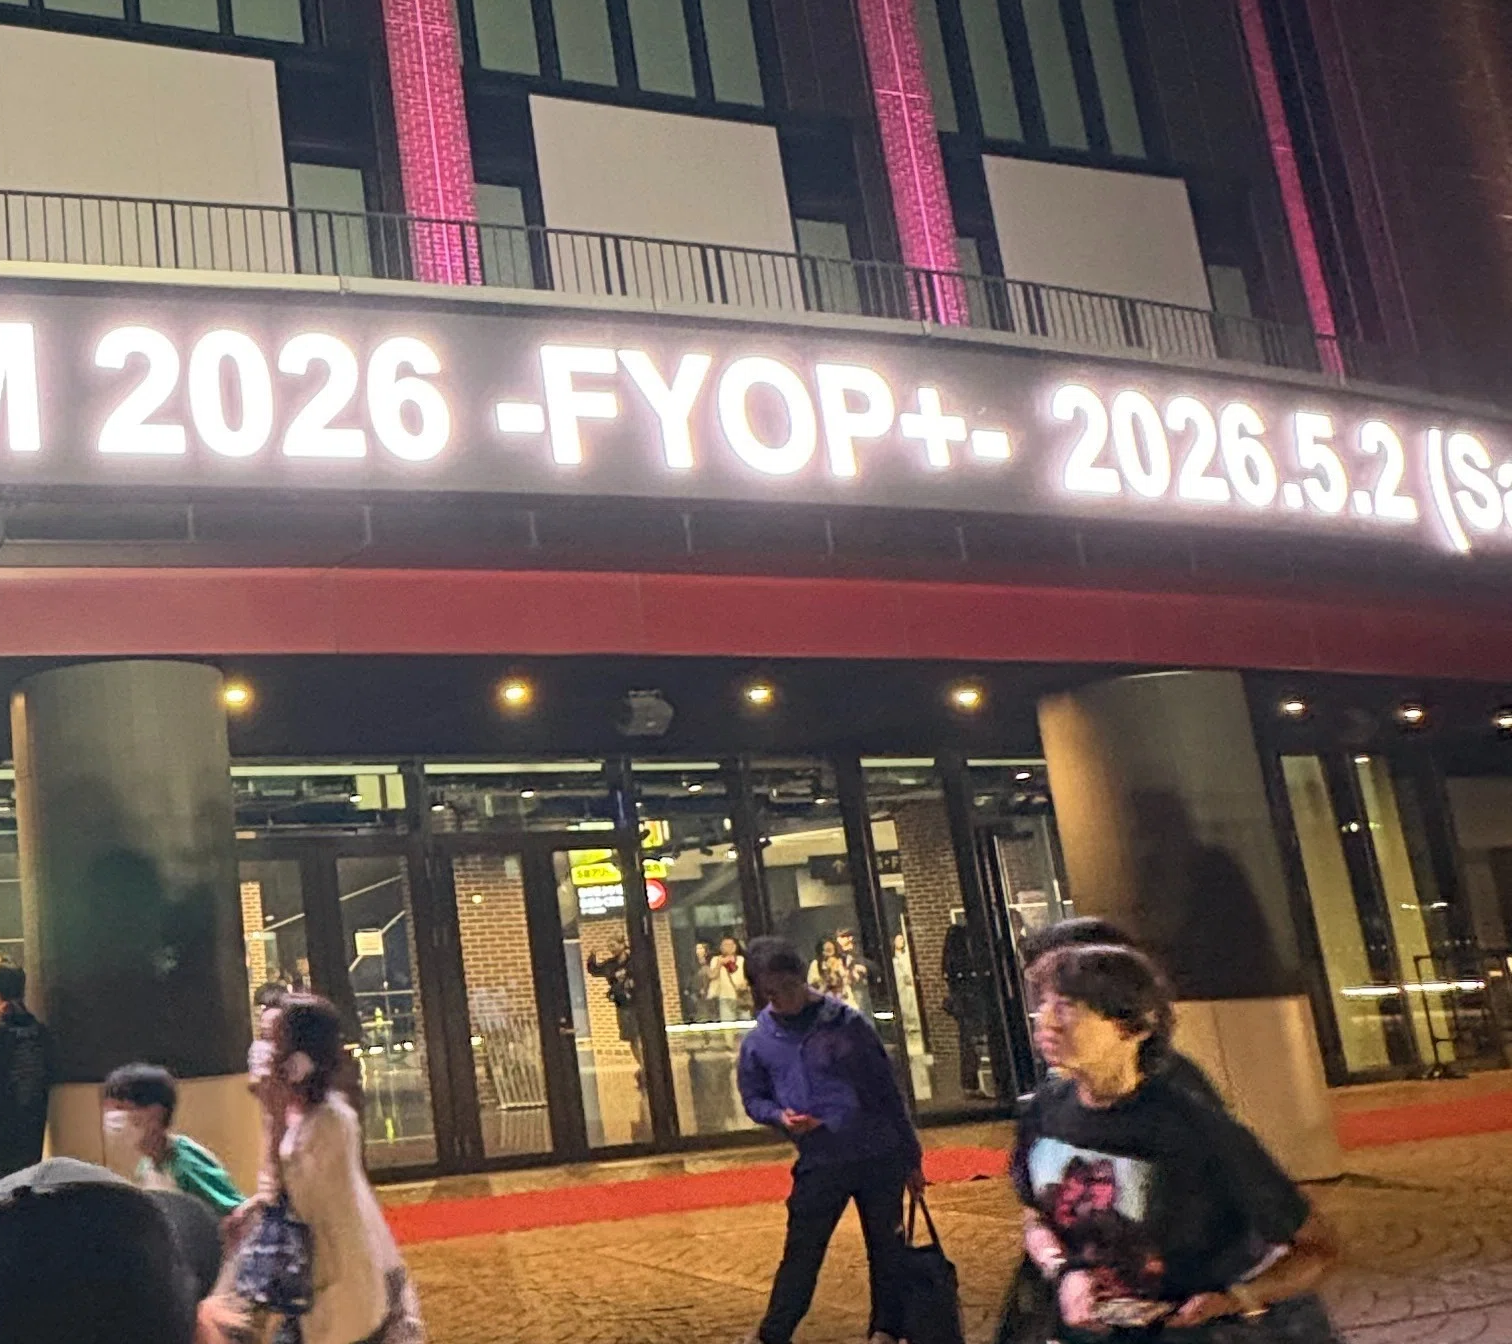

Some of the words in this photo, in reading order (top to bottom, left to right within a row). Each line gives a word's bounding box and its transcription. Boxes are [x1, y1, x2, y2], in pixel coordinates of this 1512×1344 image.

[95, 326, 449, 461] 2026
[497, 345, 1008, 477] -FYOP+-
[1052, 385, 1418, 520] 2026.5.2
